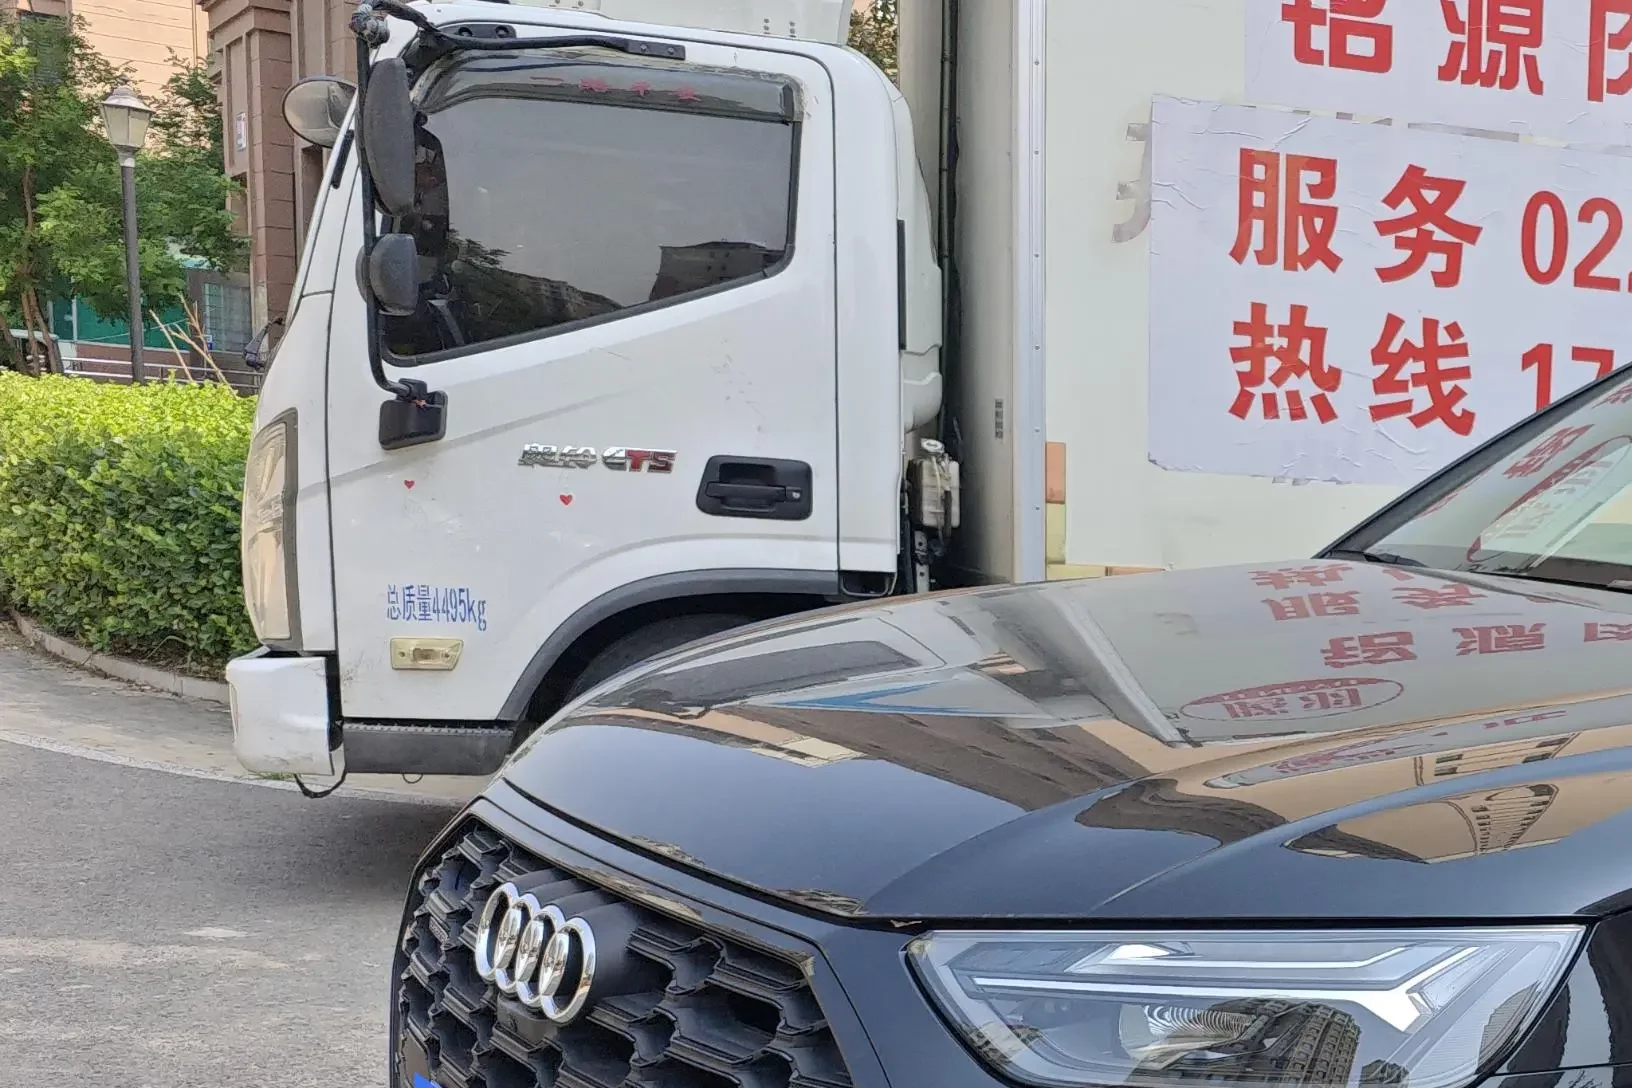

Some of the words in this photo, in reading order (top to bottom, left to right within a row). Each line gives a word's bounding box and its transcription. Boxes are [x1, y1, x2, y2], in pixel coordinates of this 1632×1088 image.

[1229, 148, 1482, 288] 服务
[1228, 302, 1475, 436] 热线
[387, 584, 487, 631] 总质量4495kg
